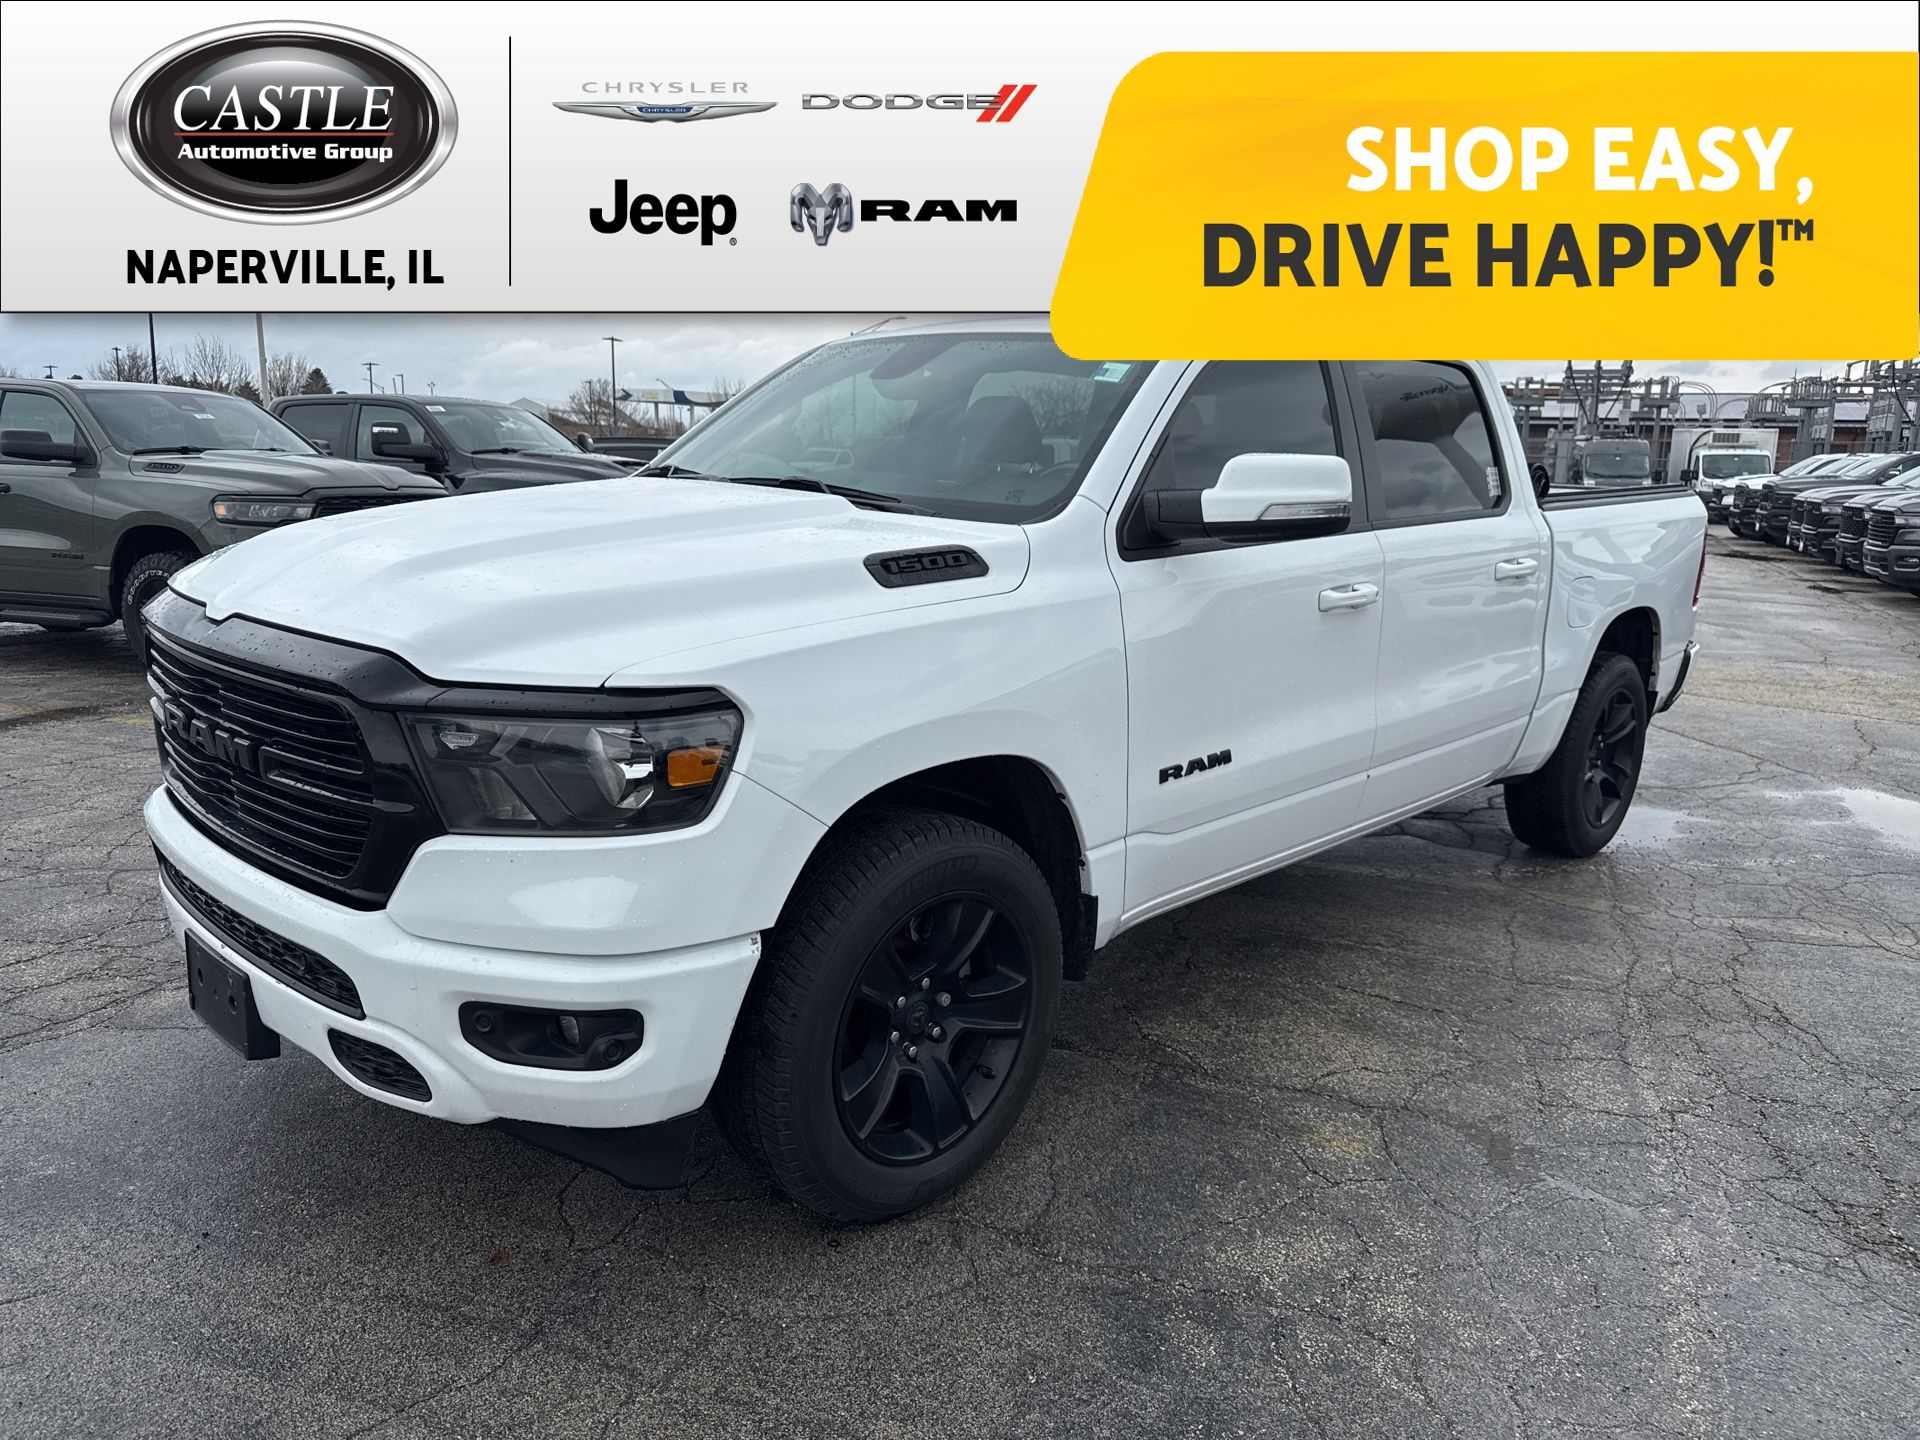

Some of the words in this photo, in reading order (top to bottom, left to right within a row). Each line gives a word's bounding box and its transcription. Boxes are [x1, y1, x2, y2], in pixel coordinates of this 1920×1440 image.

[882, 553, 967, 575] 1500
[127, 569, 170, 605] GOODYEA
[164, 701, 255, 772] RAM
[1159, 748, 1232, 785] RAM
